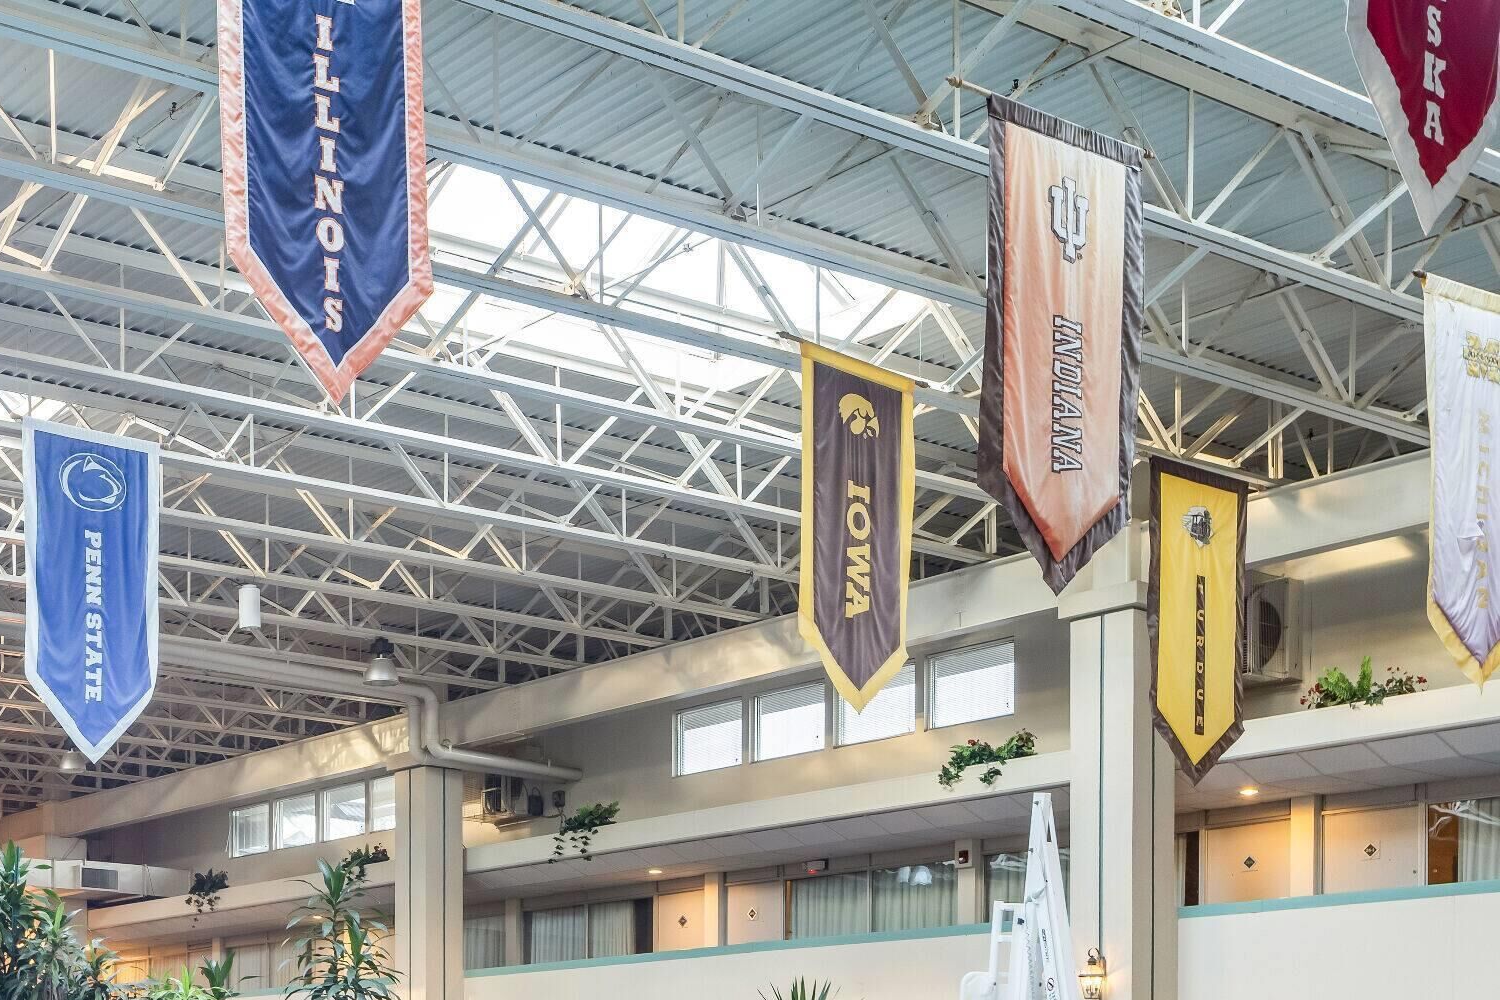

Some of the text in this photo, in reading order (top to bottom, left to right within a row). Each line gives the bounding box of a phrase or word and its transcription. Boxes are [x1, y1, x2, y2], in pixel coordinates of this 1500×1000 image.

[1423, 0, 1446, 146] SKA
[312, 14, 345, 333] ILLINOIS
[1051, 315, 1083, 474] INDIANA
[84, 529, 102, 702] PENN STATE
[845, 480, 871, 618] IOWA
